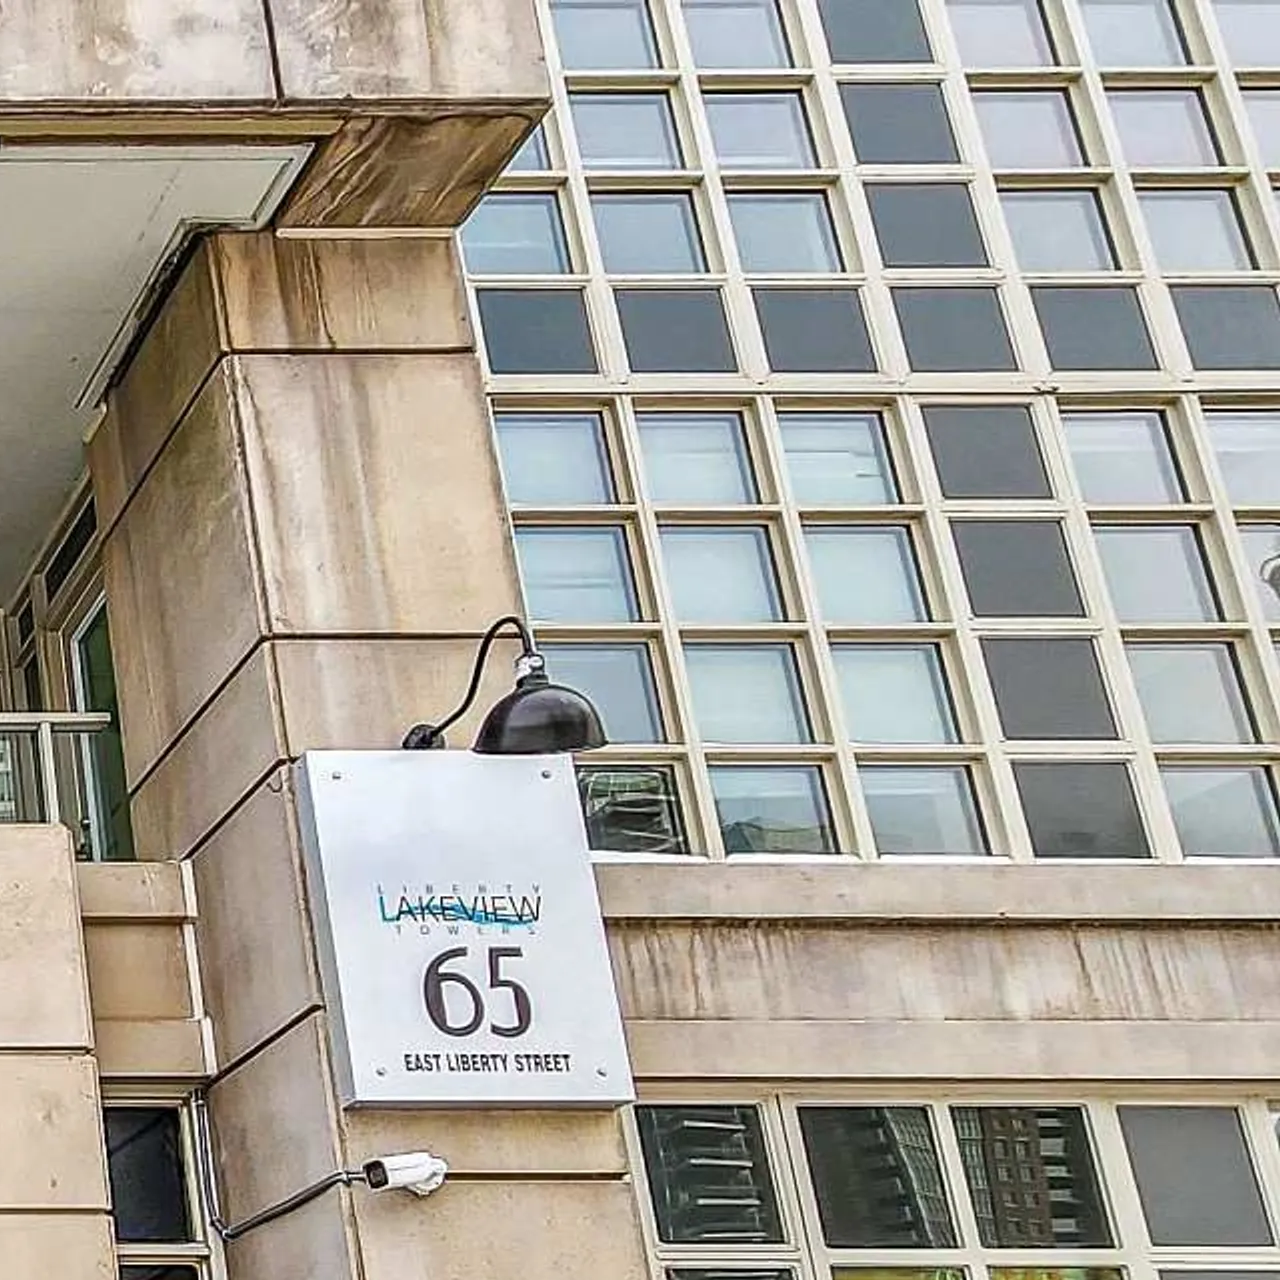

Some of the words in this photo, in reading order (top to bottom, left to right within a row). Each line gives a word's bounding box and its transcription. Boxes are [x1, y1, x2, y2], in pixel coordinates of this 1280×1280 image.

[377, 884, 540, 894] LIBERTY
[379, 896, 541, 923] LAKEVIEW
[395, 925, 536, 935] TOWERS
[423, 946, 533, 1038] 65
[405, 1054, 442, 1073] EAST
[447, 1054, 509, 1073] LIBERTY
[515, 1054, 572, 1073] STREET
